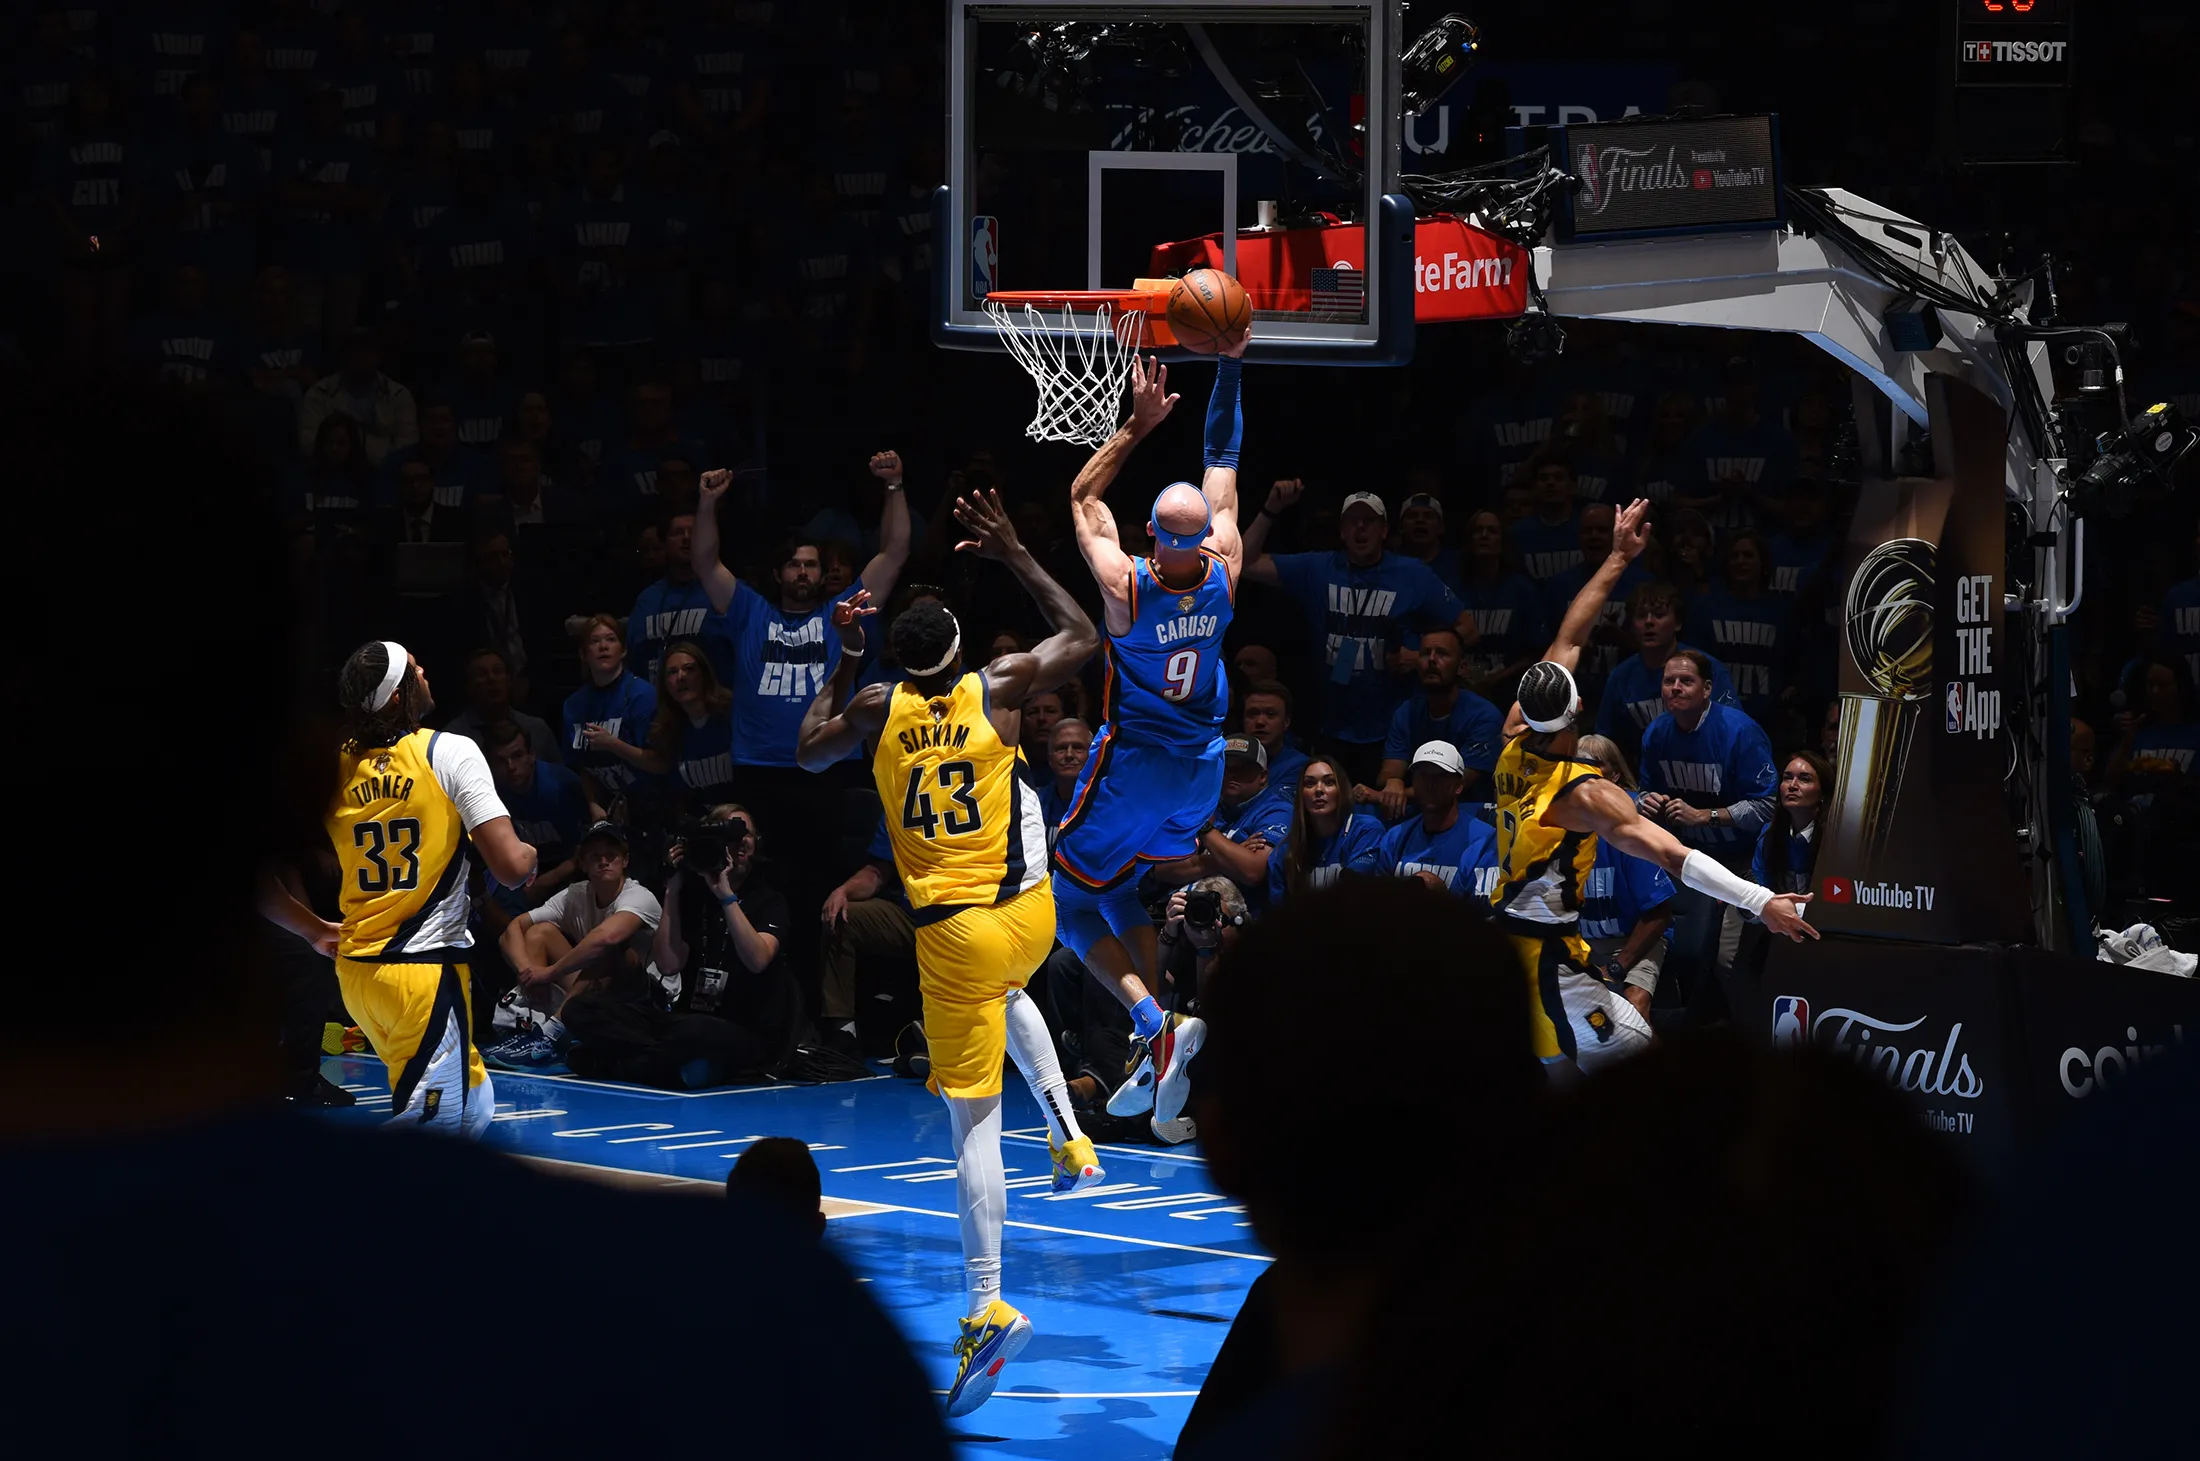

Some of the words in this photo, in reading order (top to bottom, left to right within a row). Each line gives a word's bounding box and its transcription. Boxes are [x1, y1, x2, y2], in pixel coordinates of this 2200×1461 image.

[1992, 41, 2067, 62] TISSOT
[1593, 144, 1688, 215] Finals
[1714, 168, 1751, 187] YouTube
[1751, 167, 1765, 185] TV
[1415, 252, 1512, 293] teFarm
[1957, 575, 1993, 624] GET
[1155, 615, 1218, 645] CARUSO
[1325, 633, 1386, 671] CTY
[1956, 627, 1993, 676] THE
[757, 660, 825, 696] CITY
[1160, 647, 1201, 704] 9
[1964, 682, 2001, 740] App
[898, 724, 970, 754] SIAKAM
[352, 774, 415, 807] TURNER
[902, 760, 983, 841] 43
[353, 817, 421, 893] 33
[1854, 880, 1914, 909] YouTube
[1915, 885, 1935, 911] TV
[1813, 1007, 1984, 1099] Finals
[1956, 1112, 1974, 1134] TV
[829, 1156, 1253, 1228] THUNDE
